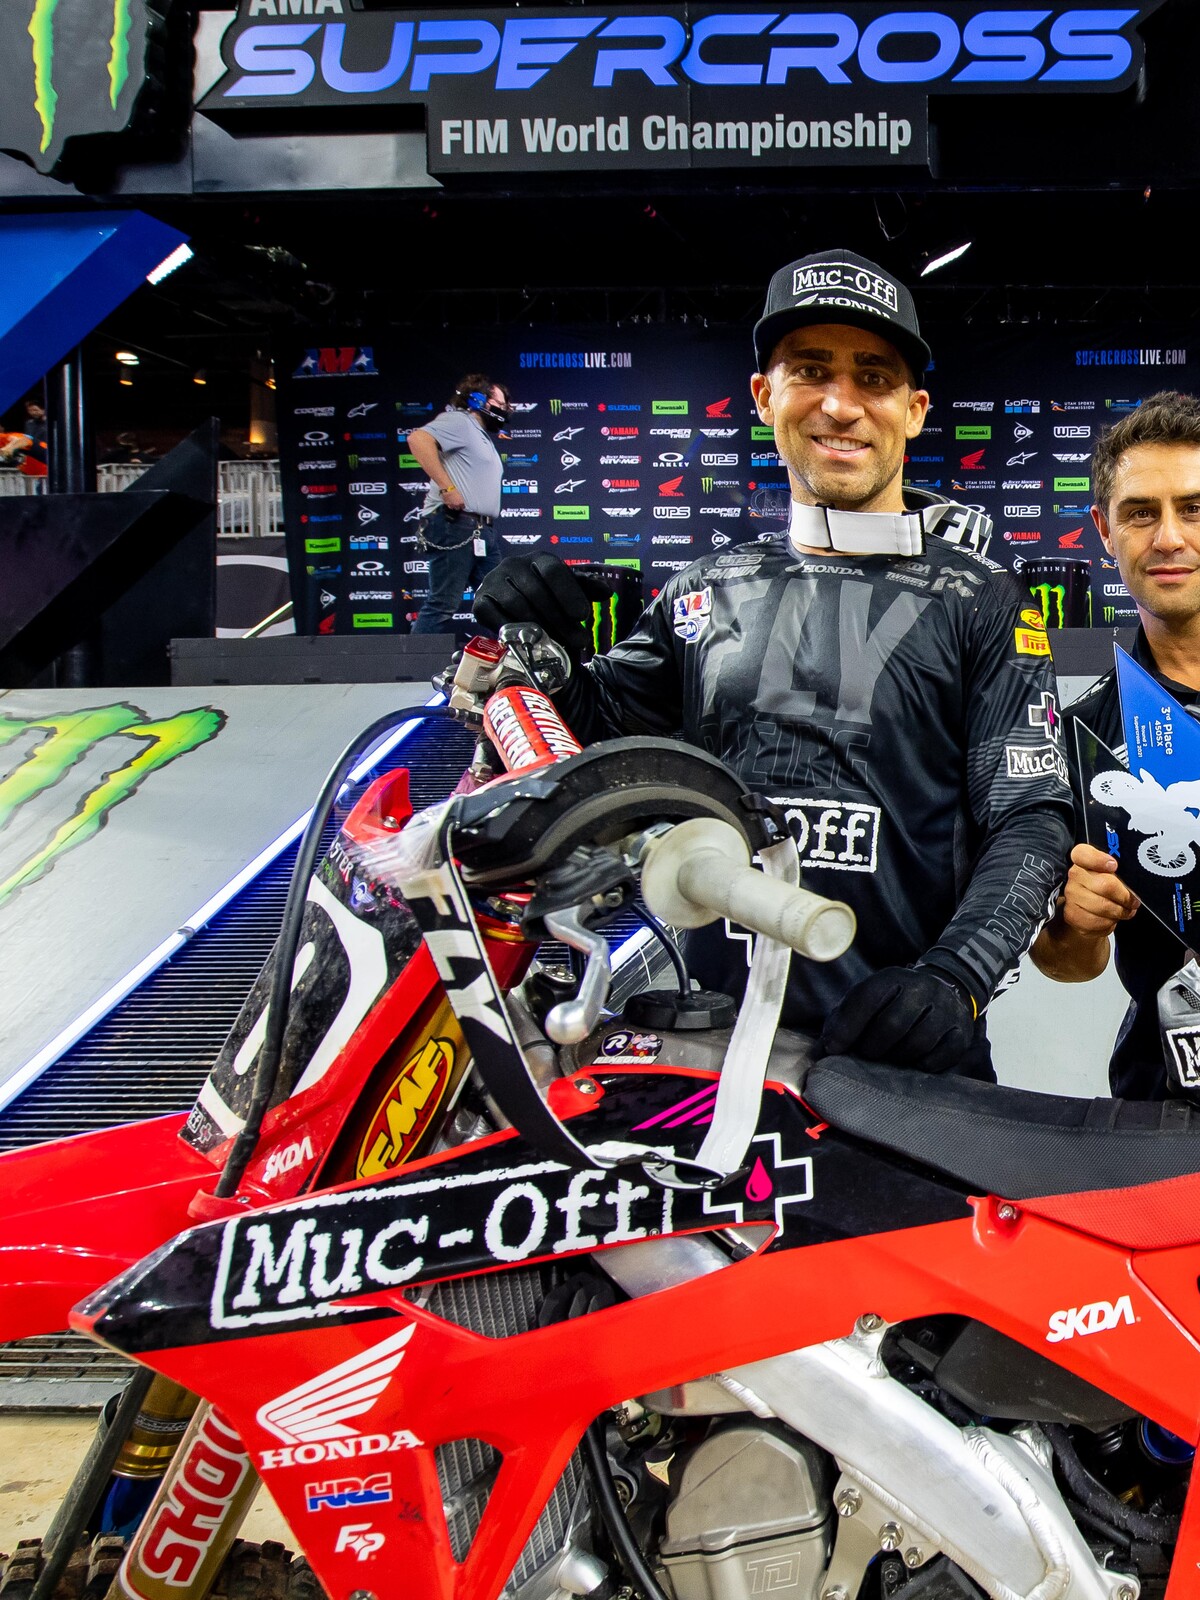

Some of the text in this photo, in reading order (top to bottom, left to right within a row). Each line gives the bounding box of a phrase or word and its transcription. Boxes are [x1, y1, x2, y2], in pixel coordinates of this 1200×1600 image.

[223, 10, 1140, 96] SUPERCROSS
[441, 112, 912, 156] FIM World Championship
[797, 269, 894, 307] Muc-Off
[520, 352, 632, 368] SUPERCROSSLIVE.COM
[1076, 350, 1186, 365] SUPERCROSSLIVE.COM
[609, 428, 638, 436] YAMAHA
[1054, 426, 1090, 438] WPS
[701, 454, 738, 466] WPS
[349, 482, 388, 494] WPS
[601, 508, 641, 516] FLY
[654, 506, 690, 518] WPS
[1004, 506, 1041, 518] WPS
[502, 535, 542, 544] FLY
[1012, 532, 1041, 540] YAMAHA
[801, 564, 865, 576] HONDA
[702, 578, 932, 725] FLY
[1154, 720, 1164, 747] 450SX
[1163, 724, 1174, 755] Place
[262, 1135, 314, 1184] SKDA
[232, 1169, 649, 1309] Muc-Off
[1046, 1295, 1136, 1343] SKDA
[259, 1430, 425, 1470] HONDA
[304, 1472, 393, 1513] HRC
